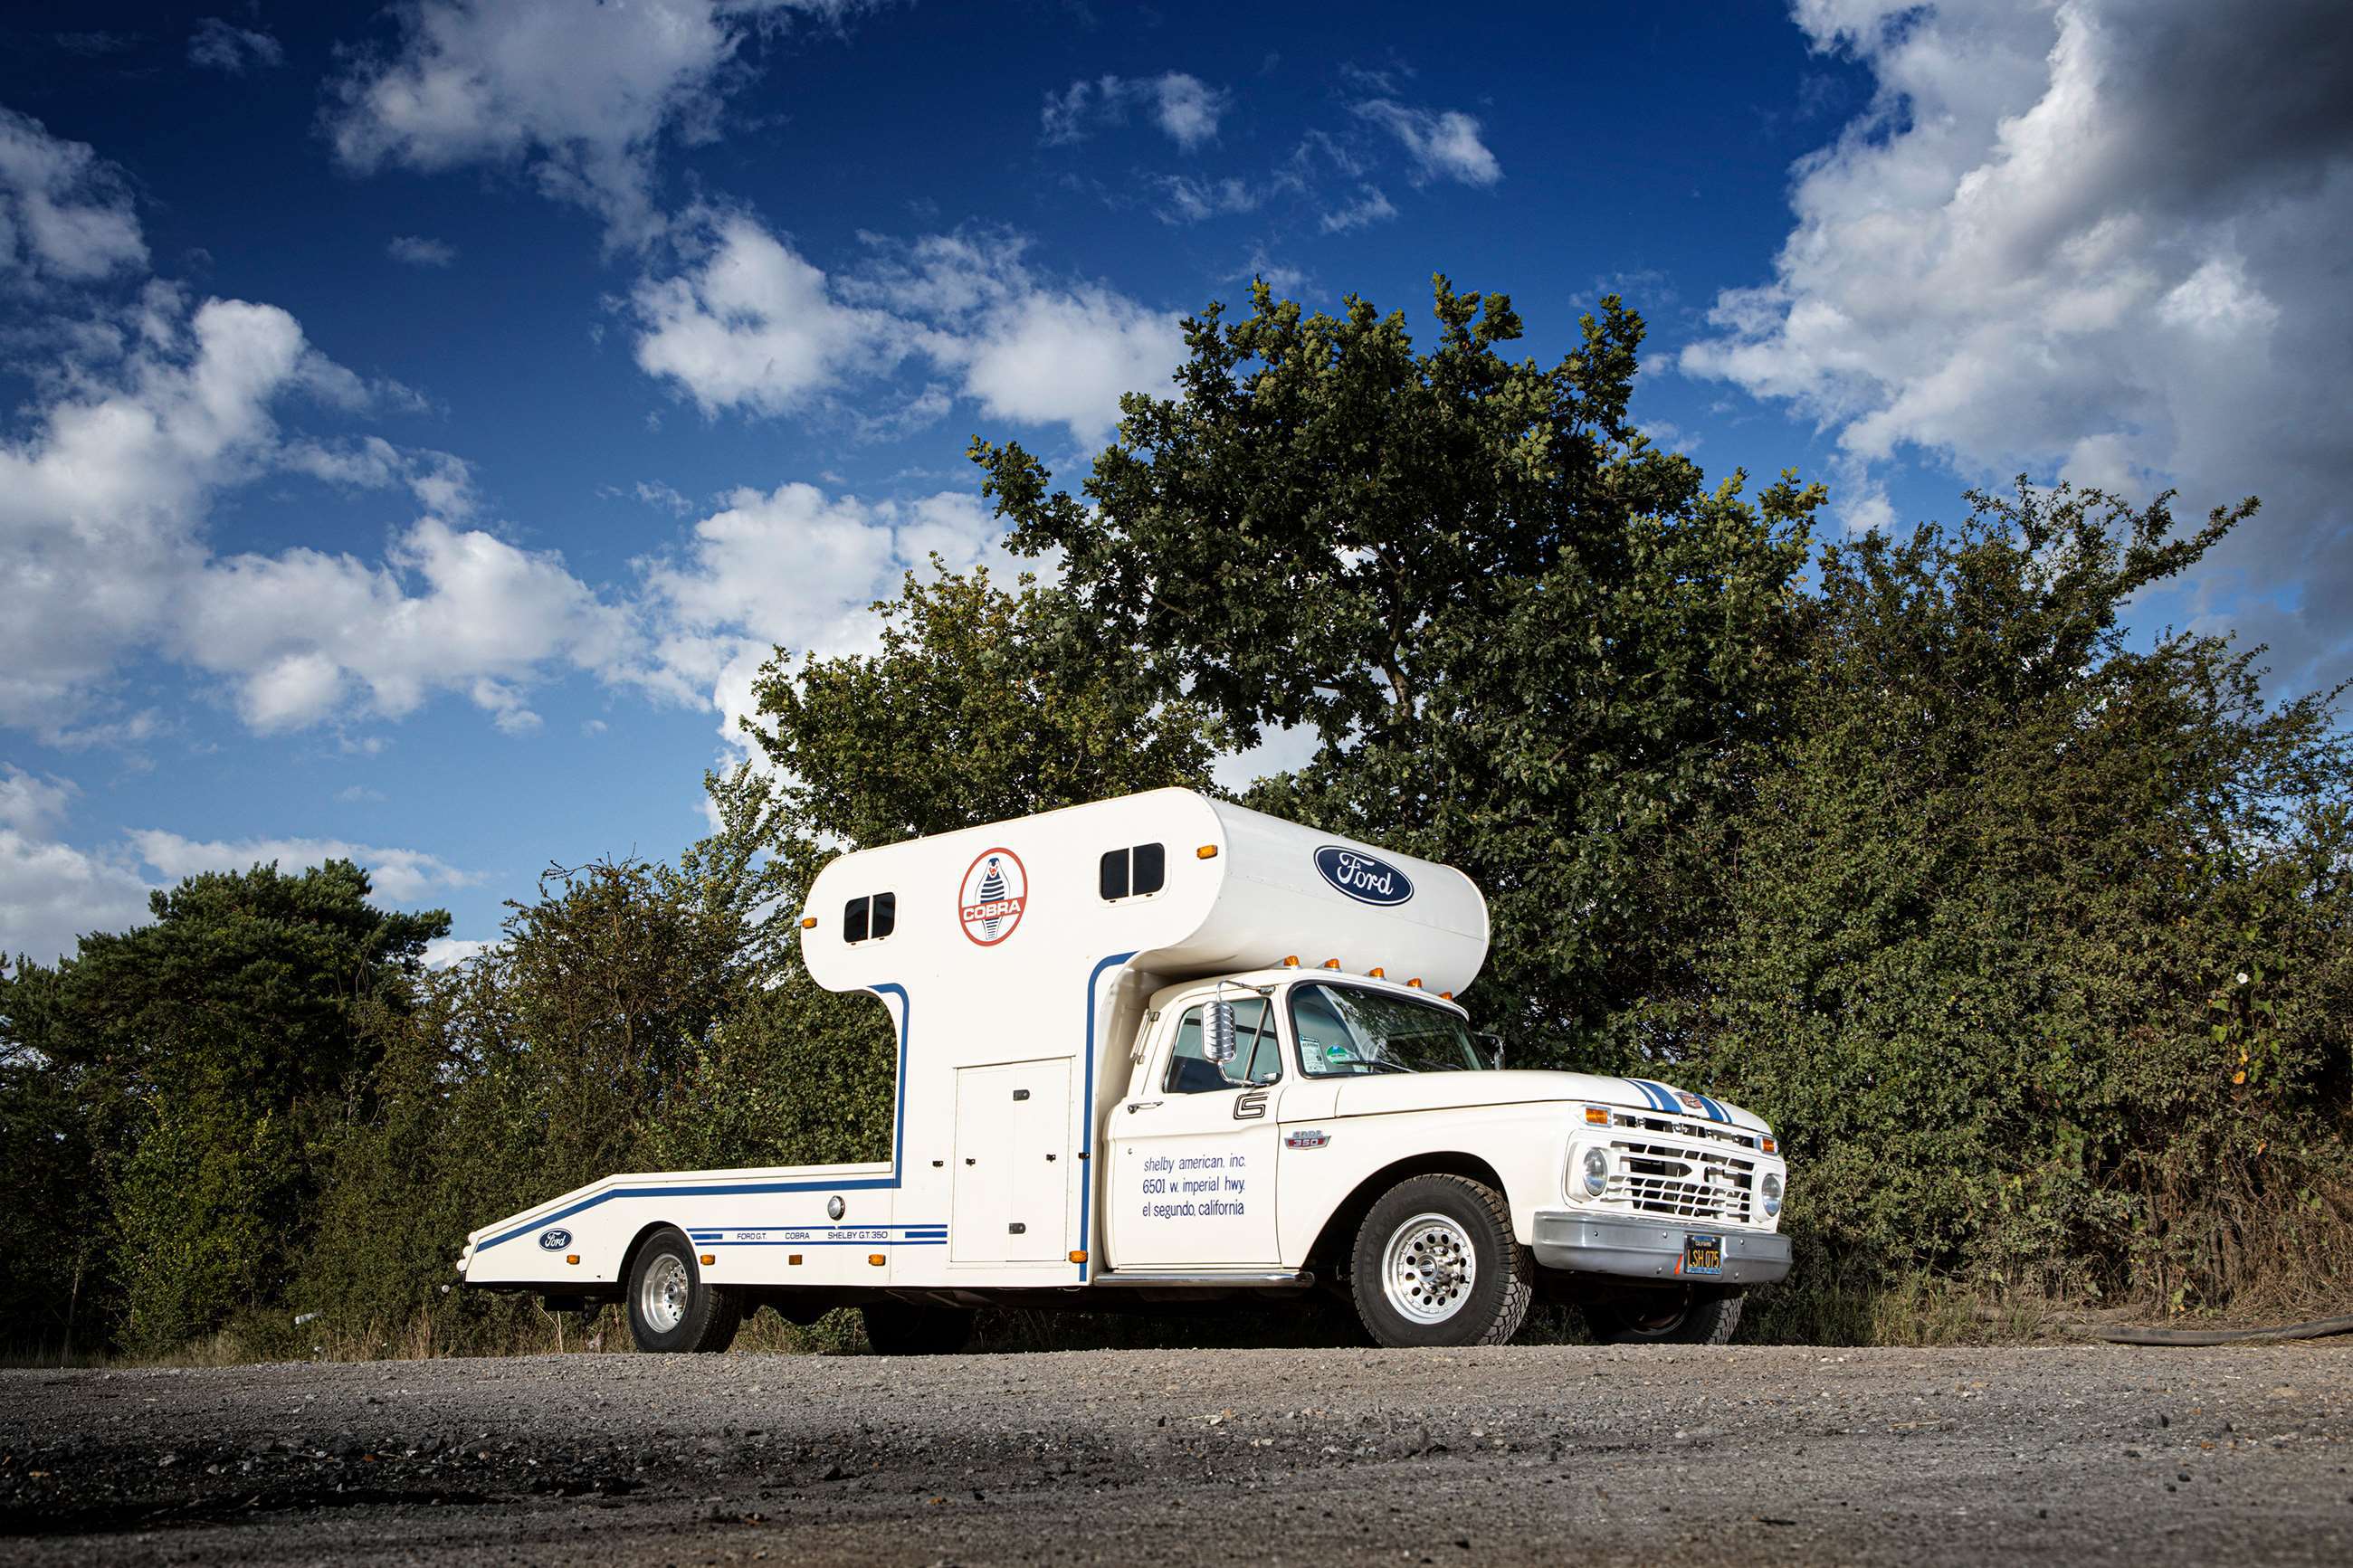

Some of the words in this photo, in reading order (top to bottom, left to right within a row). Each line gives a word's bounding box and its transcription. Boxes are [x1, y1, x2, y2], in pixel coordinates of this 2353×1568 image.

[1337, 852, 1395, 896] Ford
[963, 899, 1022, 921] COBRA
[1292, 1138, 1319, 1146] 350
[1144, 1156, 1175, 1174] shelby
[1229, 1153, 1246, 1168] inc.
[1142, 1178, 1166, 1193] 6501
[1169, 1182, 1179, 1193] w.
[1183, 1176, 1220, 1195] imperial
[1224, 1175, 1245, 1193] hwy.
[1142, 1202, 1151, 1217] el
[1198, 1199, 1244, 1216] california
[785, 1231, 811, 1240] COBRA
[827, 1231, 858, 1240] SHELBY
[871, 1231, 889, 1239] 350
